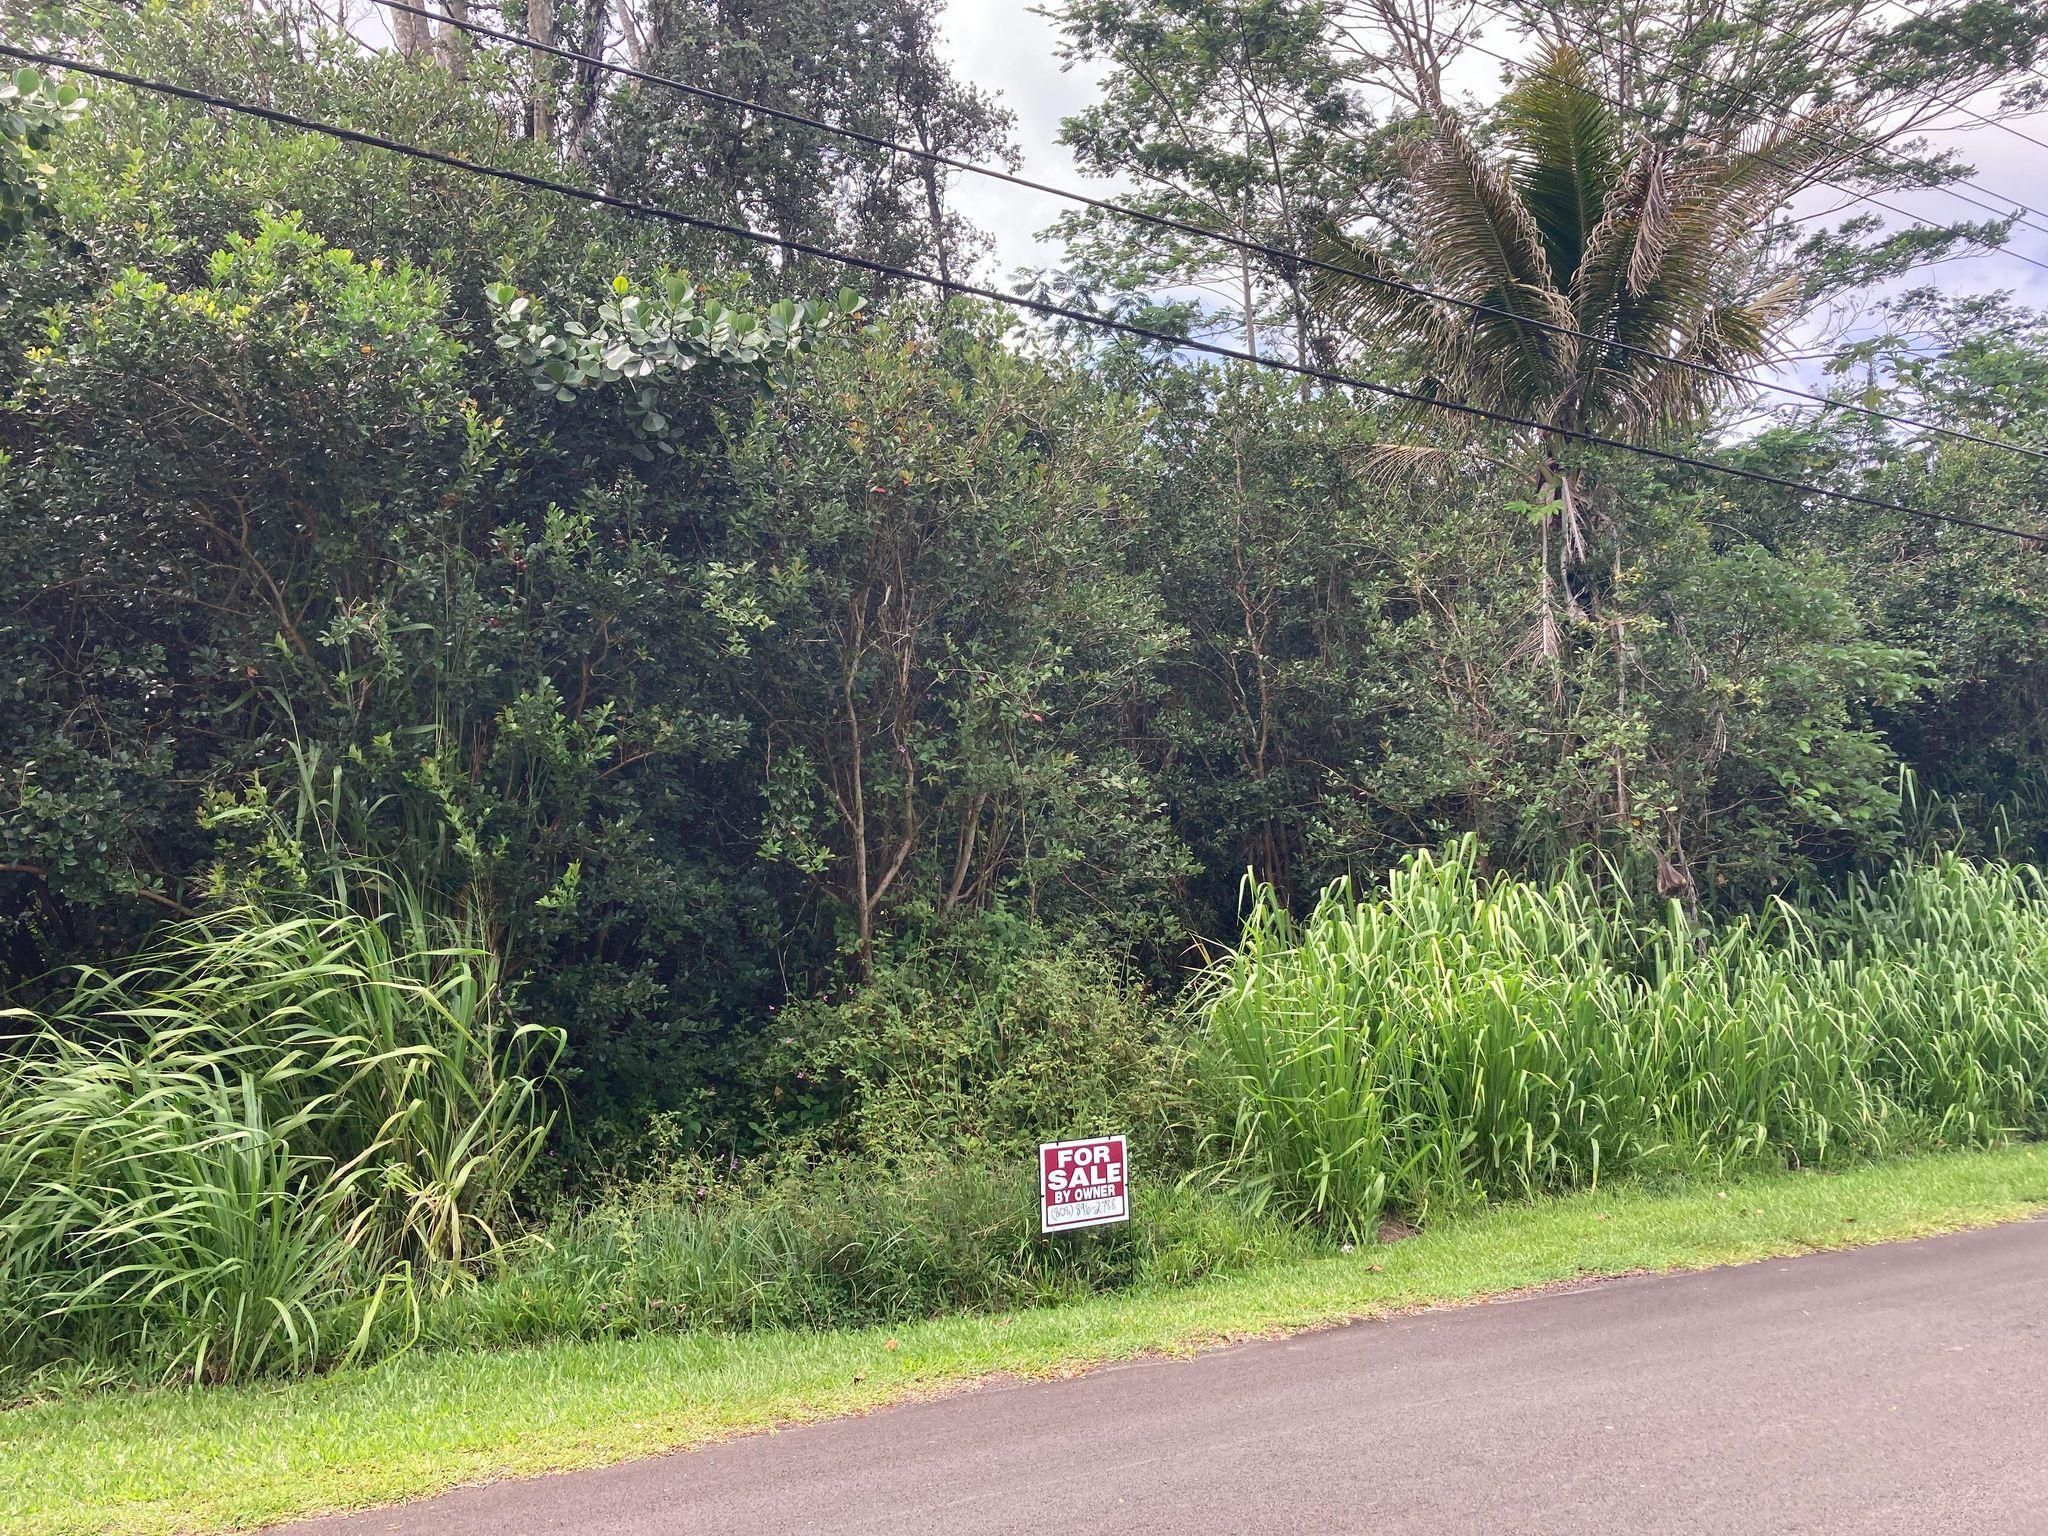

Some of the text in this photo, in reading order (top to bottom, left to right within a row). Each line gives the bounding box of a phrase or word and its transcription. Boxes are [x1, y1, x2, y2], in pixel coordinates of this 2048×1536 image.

[1057, 1145, 1110, 1168] FOR
[1047, 1162, 1121, 1191] SALE
[1054, 1184, 1115, 1204] BY OWNER
[1051, 1204, 1074, 1221] (808)
